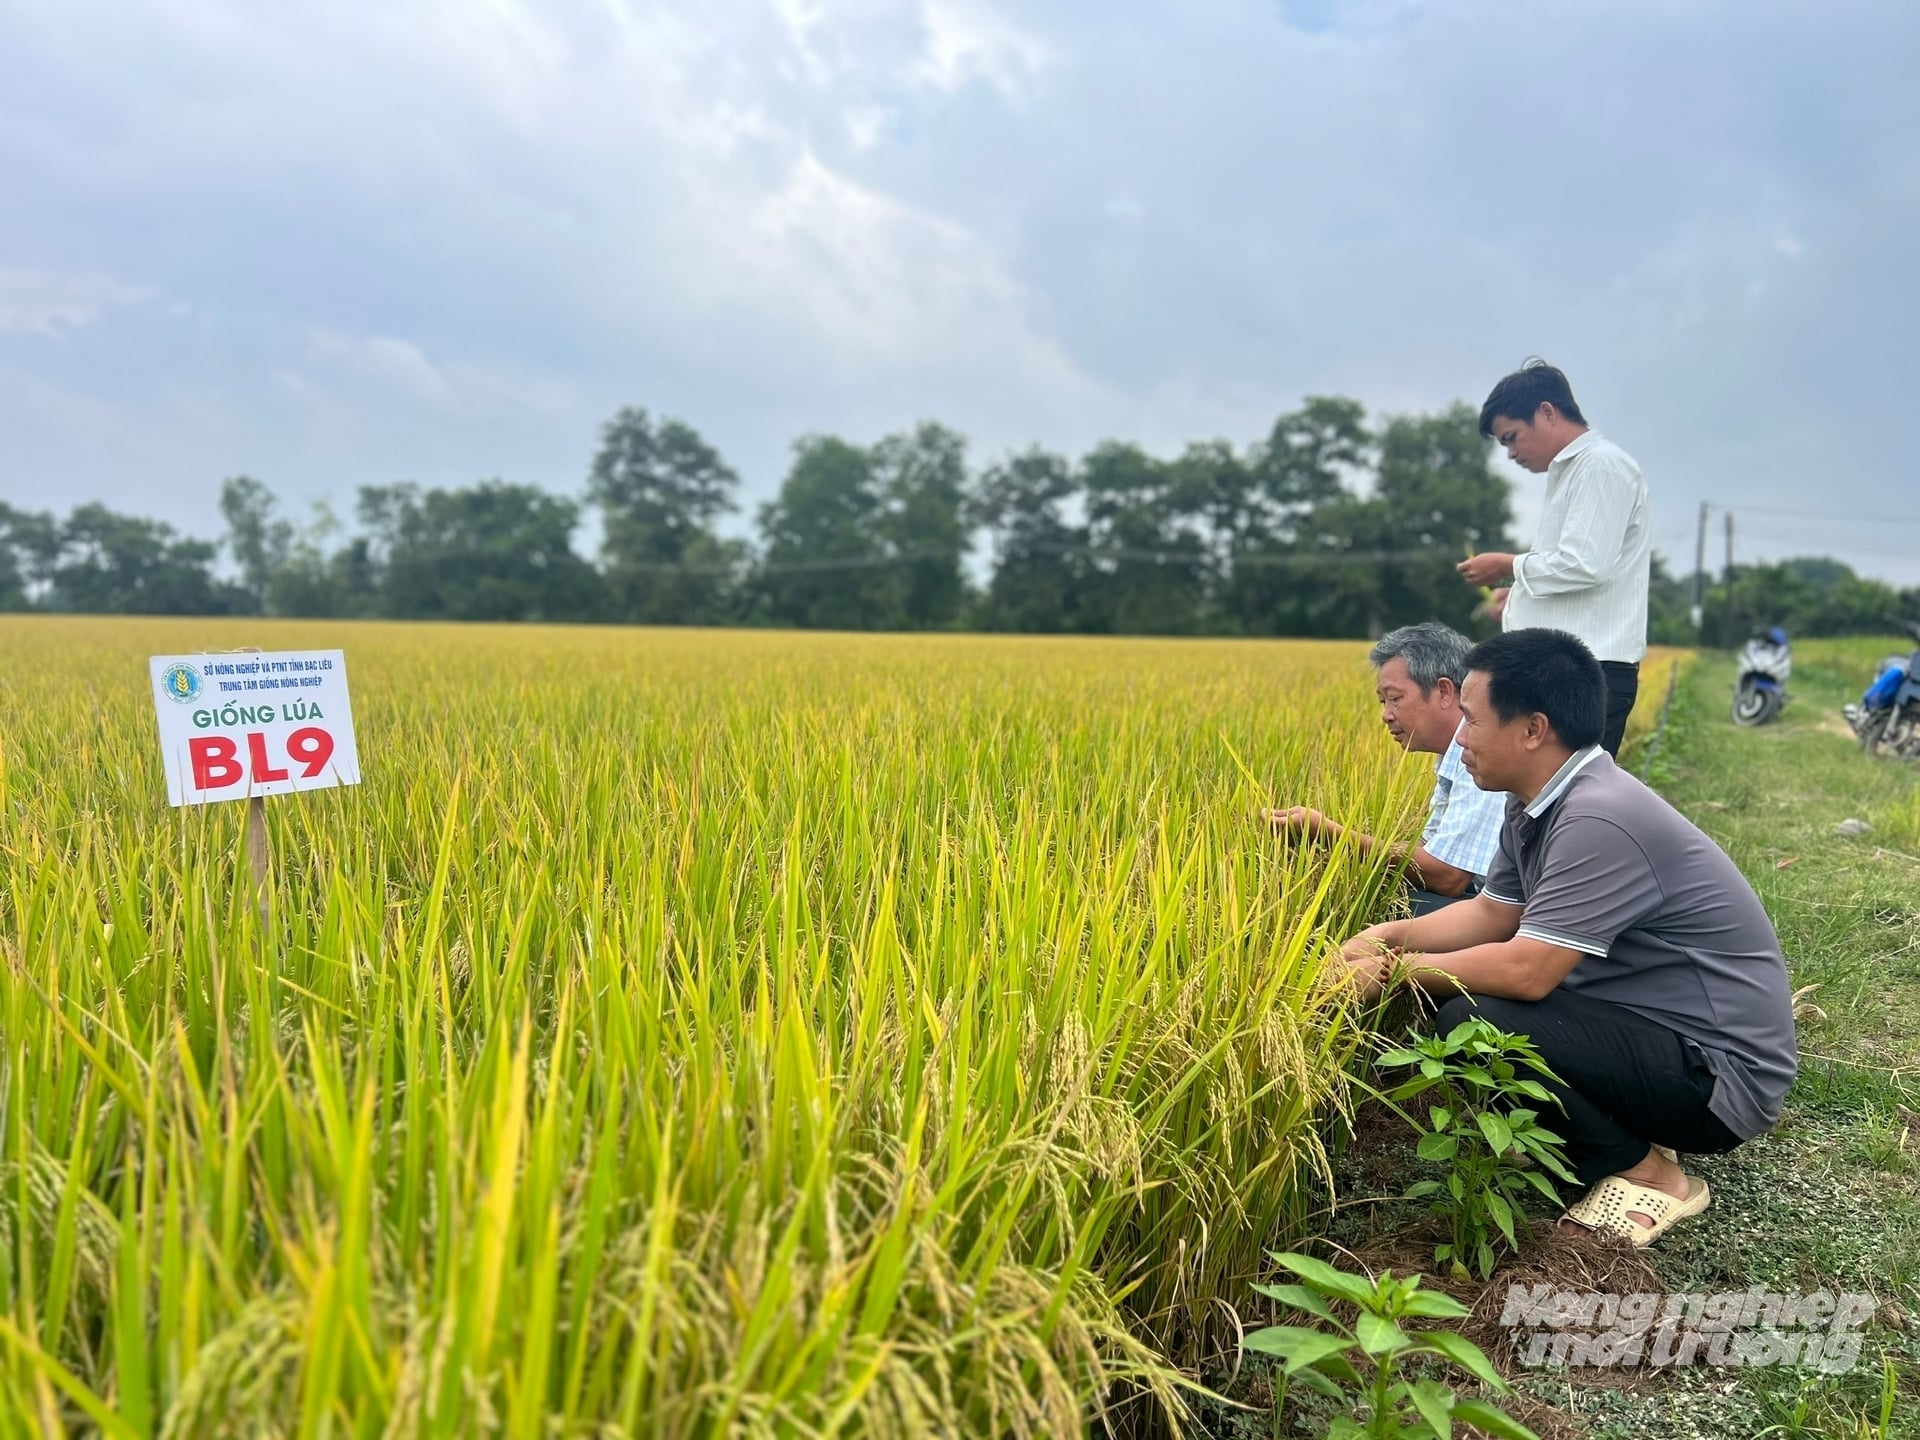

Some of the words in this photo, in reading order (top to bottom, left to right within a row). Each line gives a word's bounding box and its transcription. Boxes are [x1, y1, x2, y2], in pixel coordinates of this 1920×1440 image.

[204, 662, 213, 675] SỞ
[215, 662, 234, 675] NÔNG
[236, 661, 260, 676] NGHIỆP
[261, 660, 270, 673] VÀ
[271, 661, 287, 672] PTNT
[305, 660, 317, 673] BẠC
[318, 657, 332, 670] LIÊU
[219, 681, 242, 691] TRUNG
[243, 678, 258, 690] TÂM
[259, 676, 279, 689] GIỐNG
[280, 676, 299, 688] NÔNG
[300, 674, 322, 688] NGHIỆP
[192, 700, 275, 728] GIỐNG
[283, 697, 324, 721] LÚA
[188, 727, 334, 790] BL9
